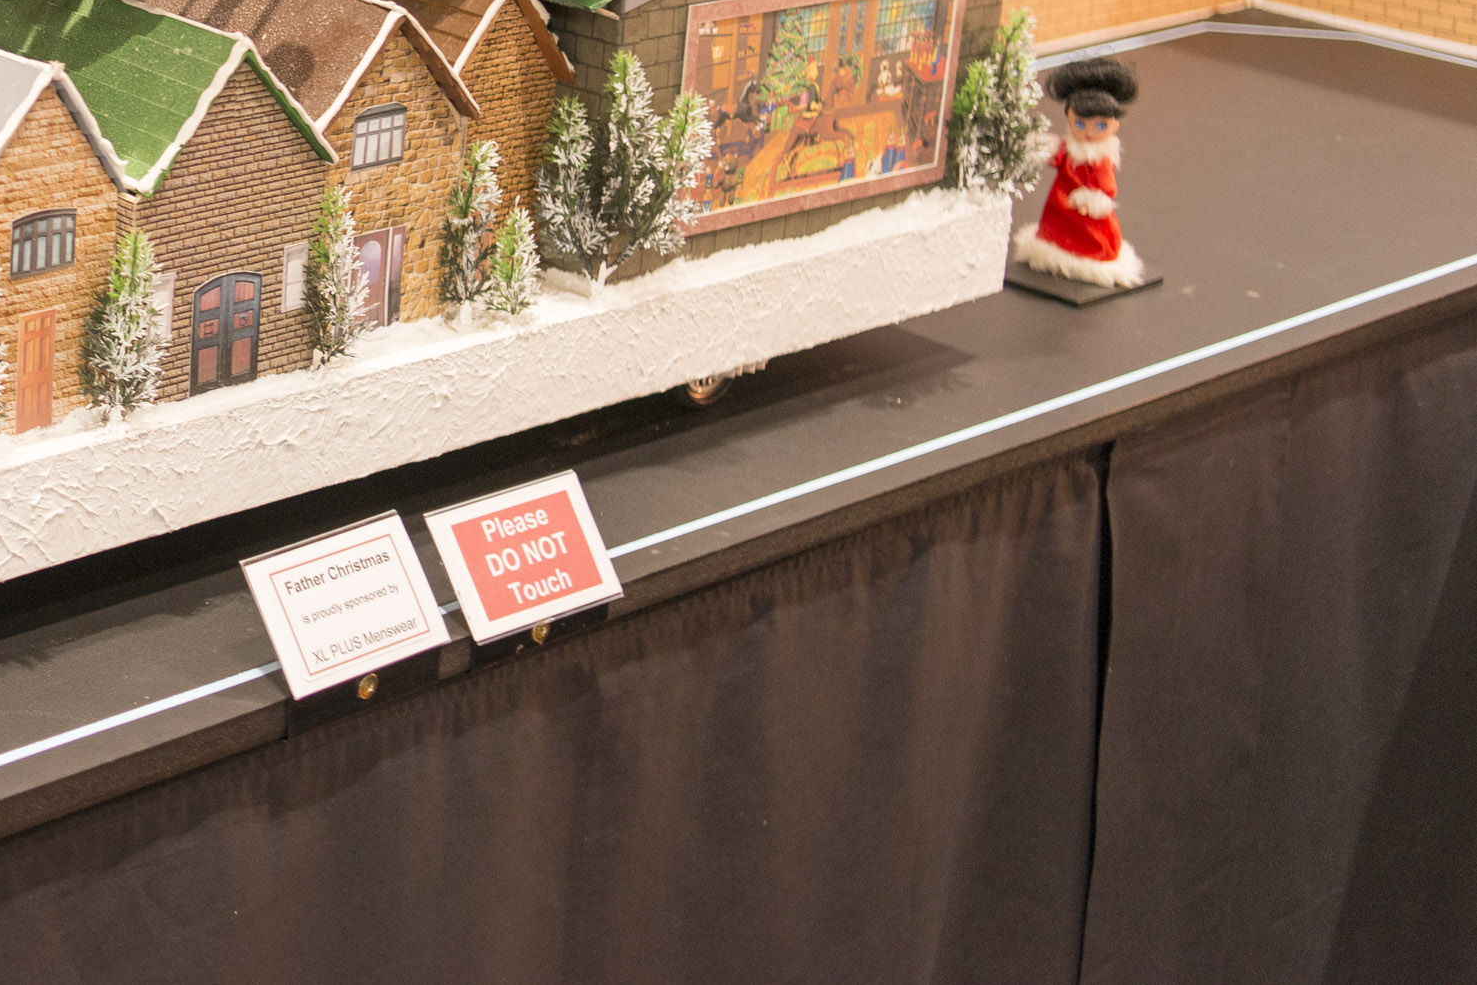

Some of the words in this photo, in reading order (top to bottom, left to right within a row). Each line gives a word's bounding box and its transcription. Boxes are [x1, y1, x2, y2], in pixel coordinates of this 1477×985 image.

[480, 509, 549, 543] Please
[284, 573, 325, 595] Father
[327, 551, 391, 580] Christmas
[484, 548, 521, 577] DO
[521, 531, 567, 565] NOT
[302, 614, 311, 624] is
[312, 603, 343, 623] proudly
[344, 588, 387, 610] sponsored
[387, 583, 400, 594] by
[506, 568, 572, 604] Touch
[311, 650, 330, 664] XL
[329, 636, 362, 658] PLUS
[363, 617, 418, 645] Menswear
